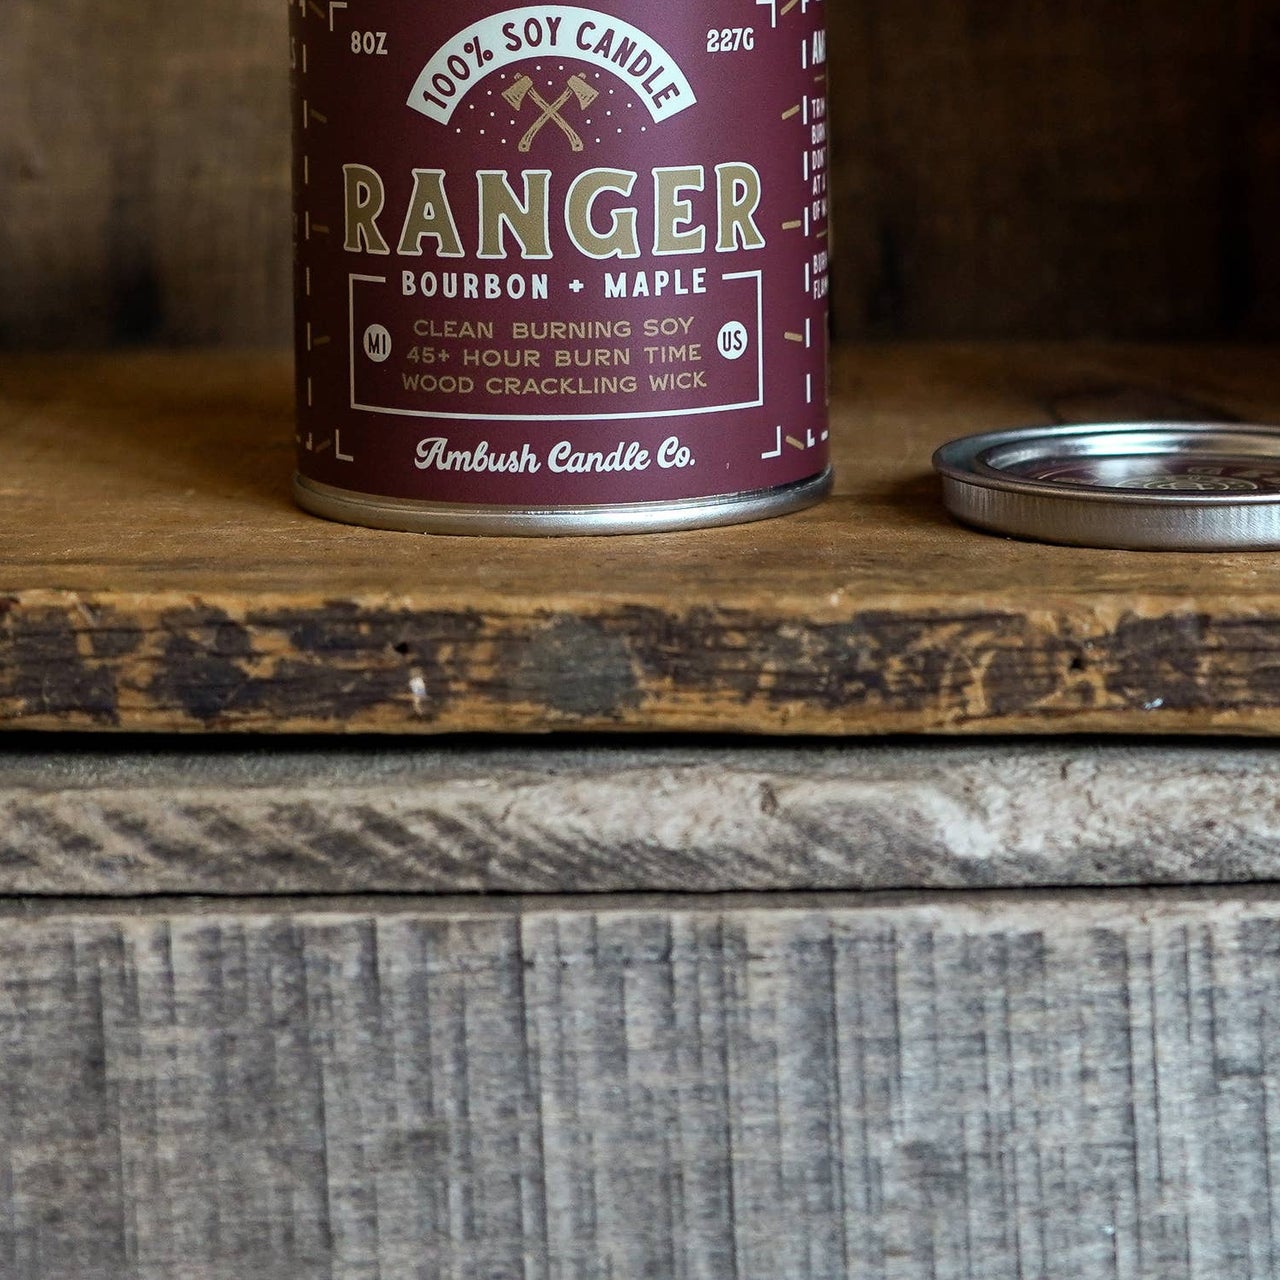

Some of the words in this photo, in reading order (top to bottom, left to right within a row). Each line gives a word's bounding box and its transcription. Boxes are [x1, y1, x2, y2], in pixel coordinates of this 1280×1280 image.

[706, 27, 755, 53] 227G
[422, 35, 494, 109] 100%
[502, 16, 562, 52] SOY
[575, 21, 681, 110] CANDLE
[342, 161, 766, 260] RANGER
[401, 270, 549, 300] BOURBON
[604, 268, 707, 299] MAPLE
[413, 319, 494, 339] CLEAN
[512, 319, 632, 340] BURNING
[643, 316, 696, 337] SOY
[722, 329, 743, 352] US
[367, 331, 388, 355] MI
[406, 347, 450, 364] 45+
[463, 349, 541, 368] HOUR
[554, 347, 631, 368] BURN
[643, 344, 703, 365] TIME
[401, 373, 475, 394] WOOD
[485, 374, 638, 395] CRACKLING
[648, 370, 708, 392] WICK
[413, 436, 542, 474] Ambush
[546, 439, 652, 474] Candle
[655, 435, 697, 470] Co.
